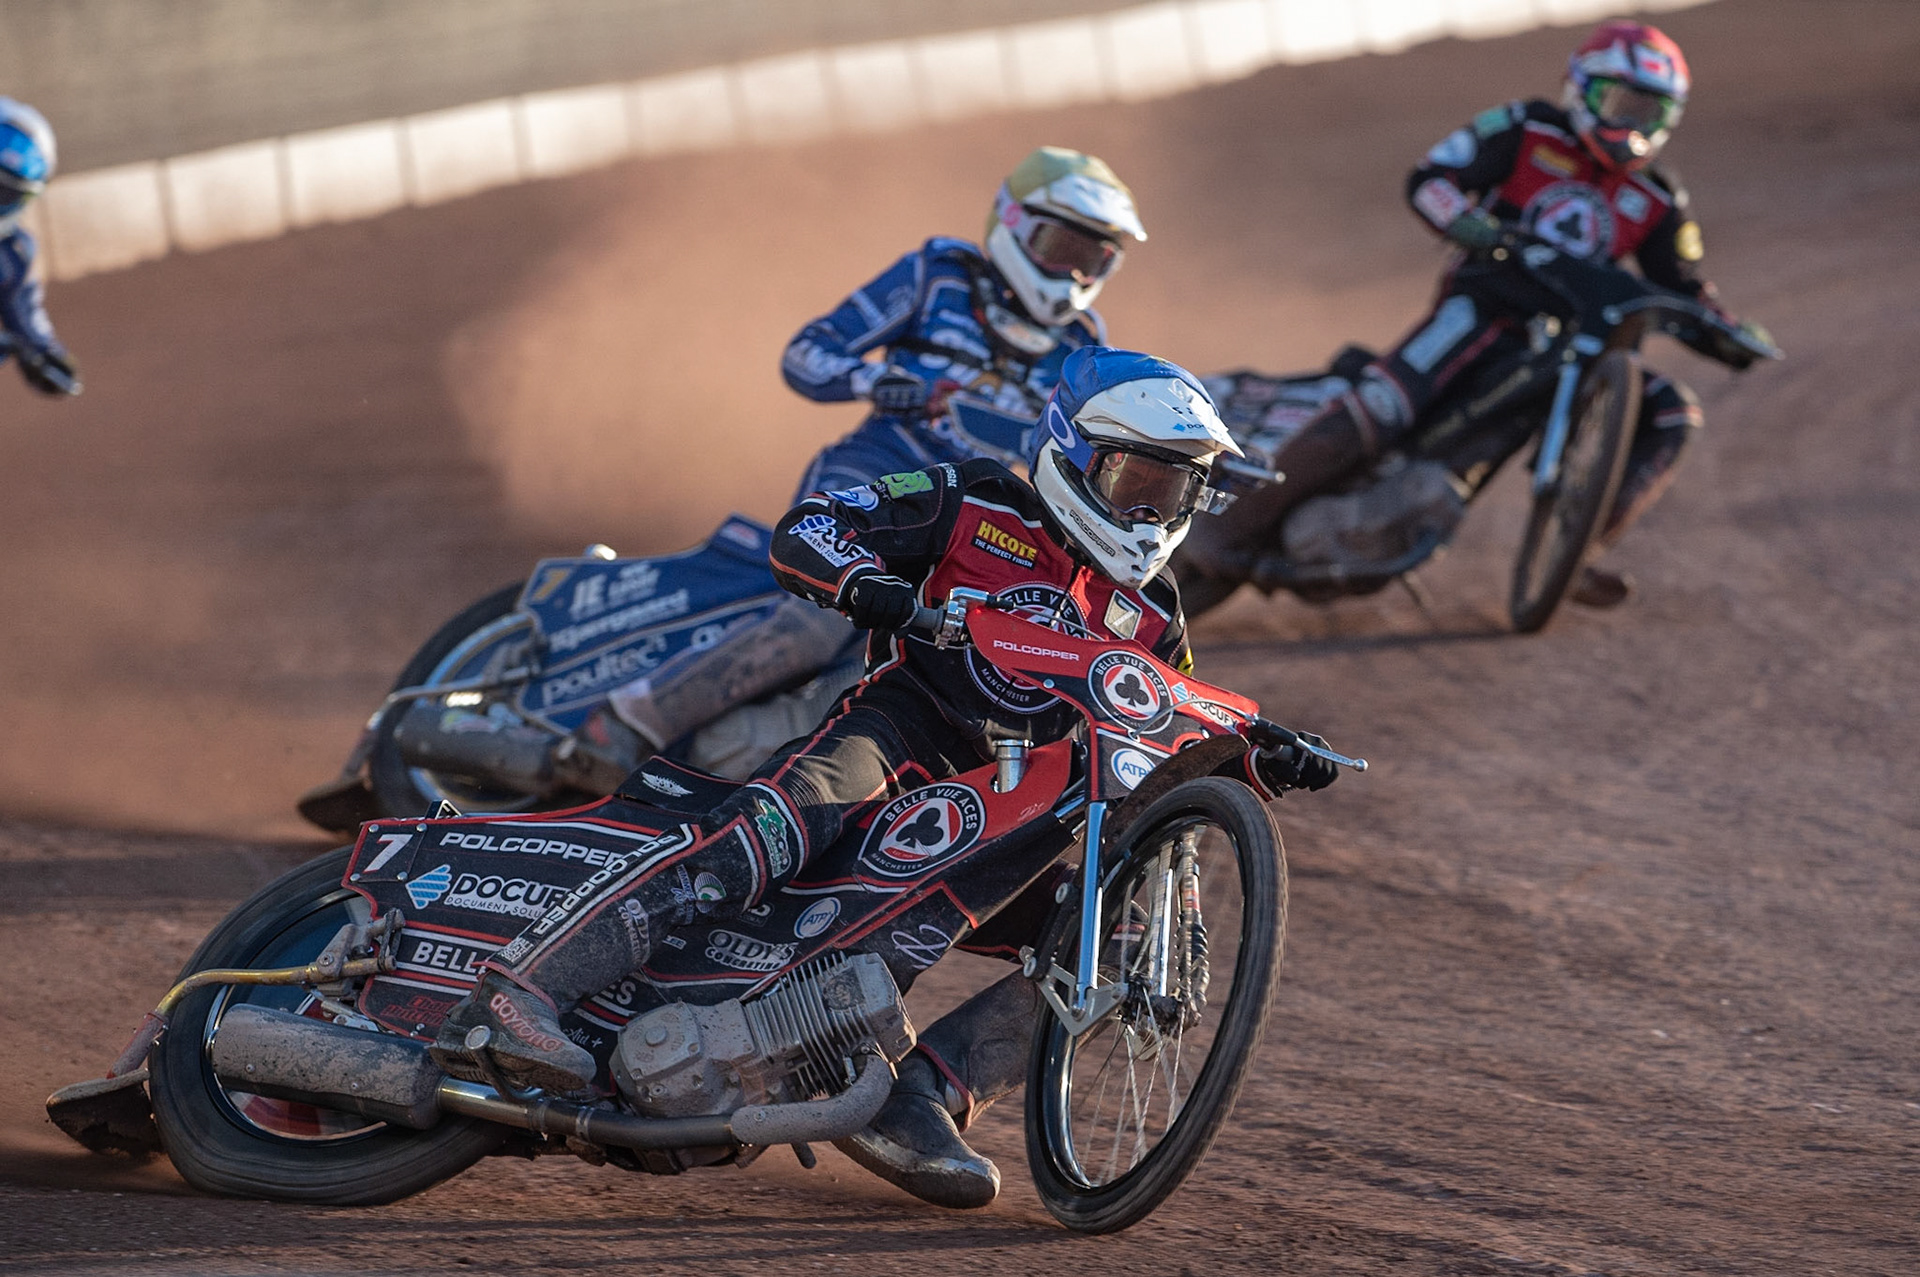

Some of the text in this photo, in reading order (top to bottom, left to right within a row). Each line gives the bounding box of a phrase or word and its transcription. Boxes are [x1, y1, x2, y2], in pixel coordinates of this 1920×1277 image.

[977, 520, 1038, 561] HYCOTE
[1069, 509, 1116, 557] POLCOPPER
[974, 537, 1034, 568] THE PERFECT FINISH
[1005, 590, 1041, 604] ELLE
[1112, 599, 1136, 627] 7
[993, 640, 1080, 661] POLCOPPER
[1095, 655, 1168, 697] BELLE VUE ACES
[885, 790, 928, 822] BELLE
[936, 787, 963, 799] VUE
[958, 797, 979, 830] ACES
[363, 833, 414, 873] 7
[871, 853, 922, 871] MANCHESTER
[532, 835, 678, 935] POLCOPPER
[446, 896, 508, 914] DOCUMENT
[412, 941, 486, 974] BELL
